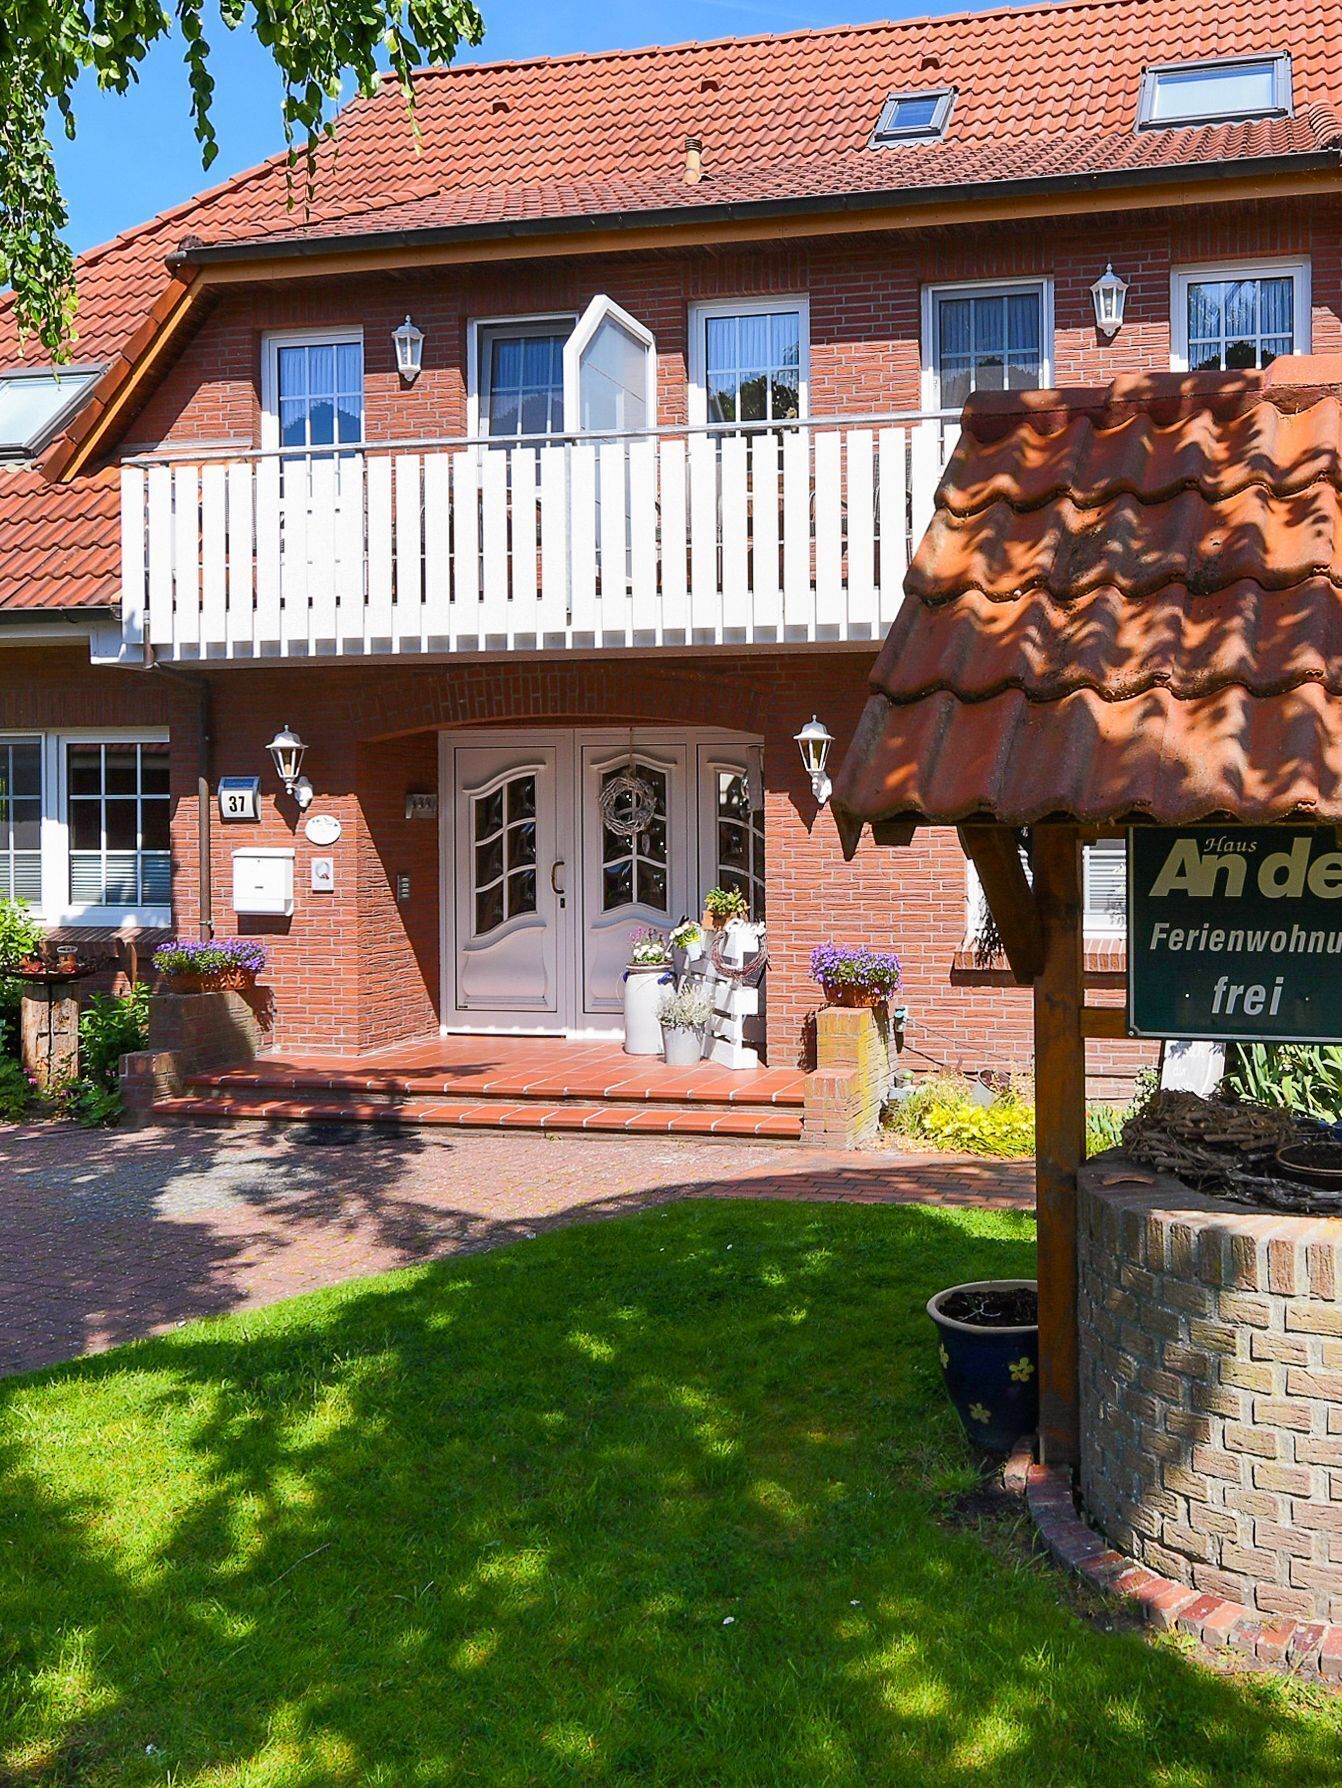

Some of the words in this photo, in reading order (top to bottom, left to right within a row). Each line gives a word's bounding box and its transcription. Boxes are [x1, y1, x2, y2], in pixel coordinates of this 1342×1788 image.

[229, 796, 245, 812] 37
[1203, 836, 1258, 853] Haus
[1149, 838, 1248, 897] An
[1211, 976, 1285, 1016] frei
